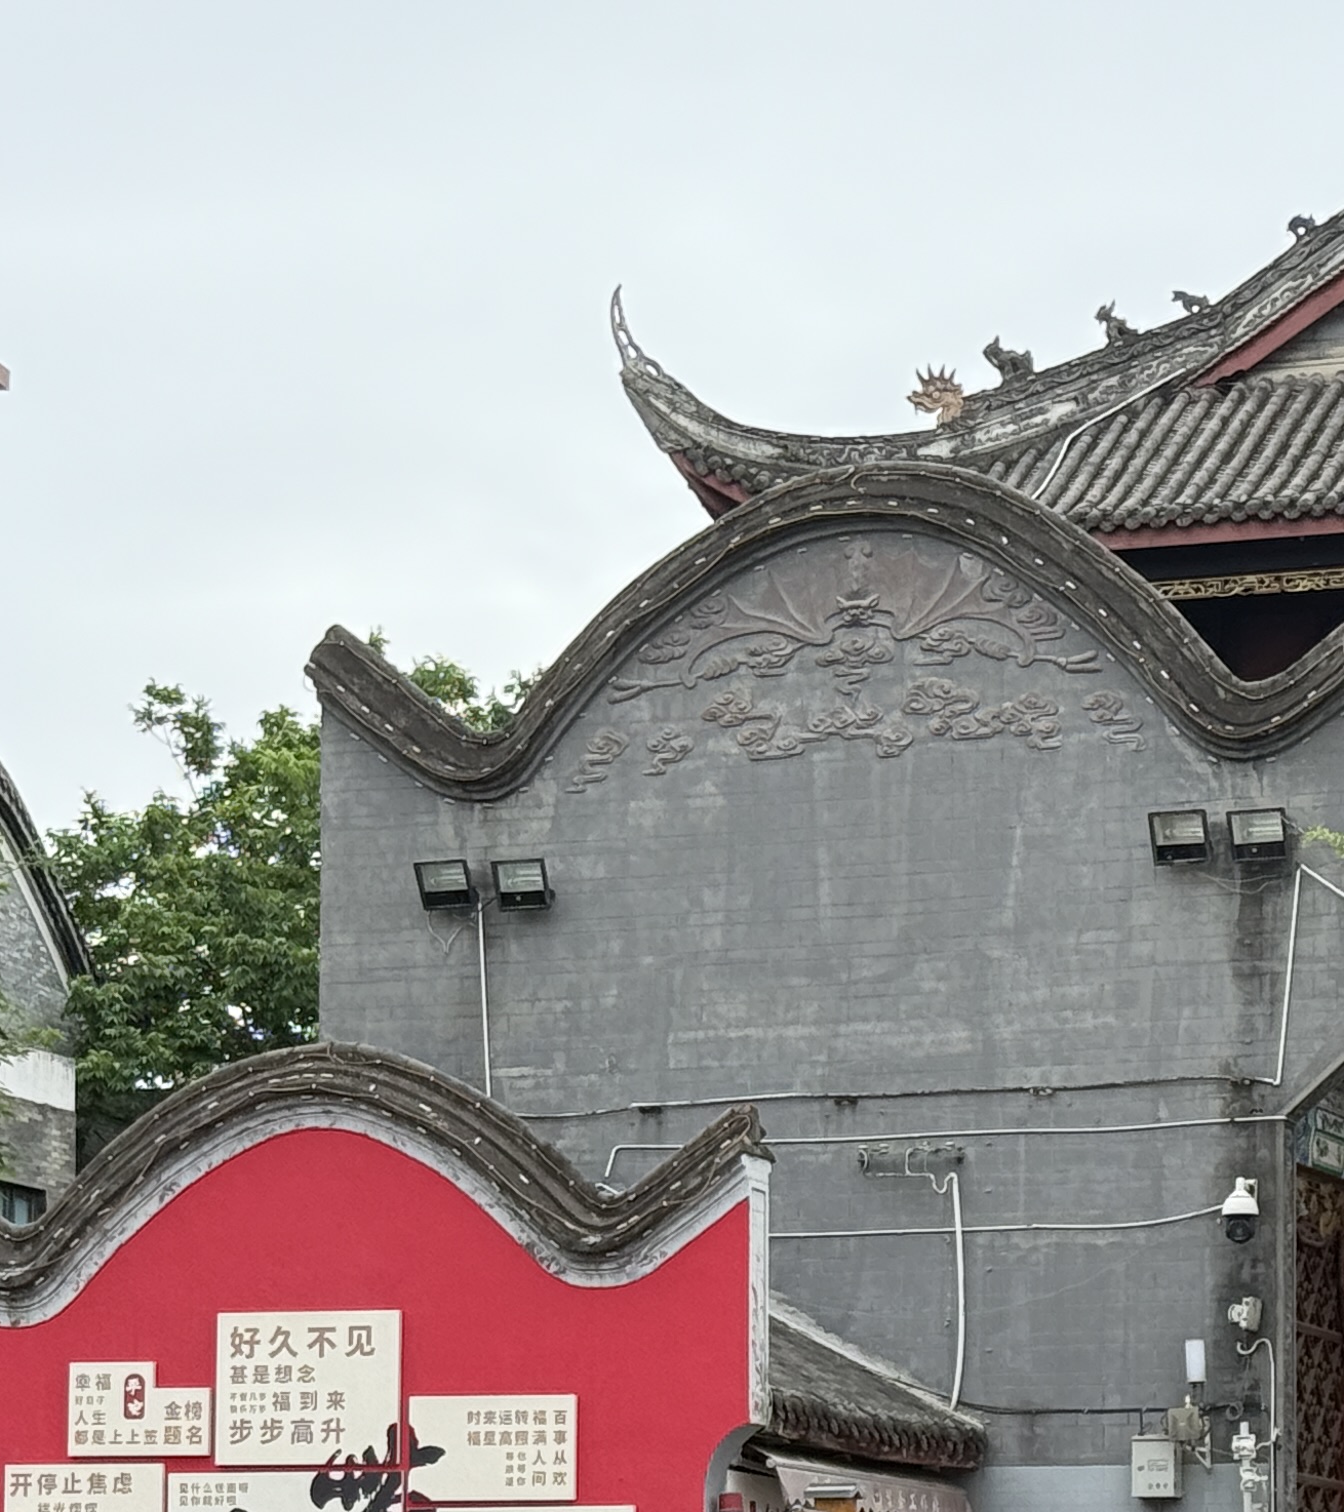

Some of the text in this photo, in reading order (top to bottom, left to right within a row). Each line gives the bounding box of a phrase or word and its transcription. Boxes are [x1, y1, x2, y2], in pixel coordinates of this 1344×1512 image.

[230, 1325, 376, 1359] 好久不见
[75, 1373, 112, 1391] 幸福
[230, 1364, 316, 1385] 甚是想念
[125, 1376, 145, 1417] 平安
[272, 1390, 346, 1412] 福到来
[74, 1410, 107, 1426] 人生
[164, 1400, 203, 1421] 金榜
[467, 1410, 529, 1426] 时来运转
[74, 1428, 158, 1445] 都是上上签
[163, 1425, 203, 1445] 题名
[229, 1417, 346, 1445] 步步高升
[467, 1430, 529, 1447] 福星高照
[37, 1472, 133, 1495] 停止焦虑
